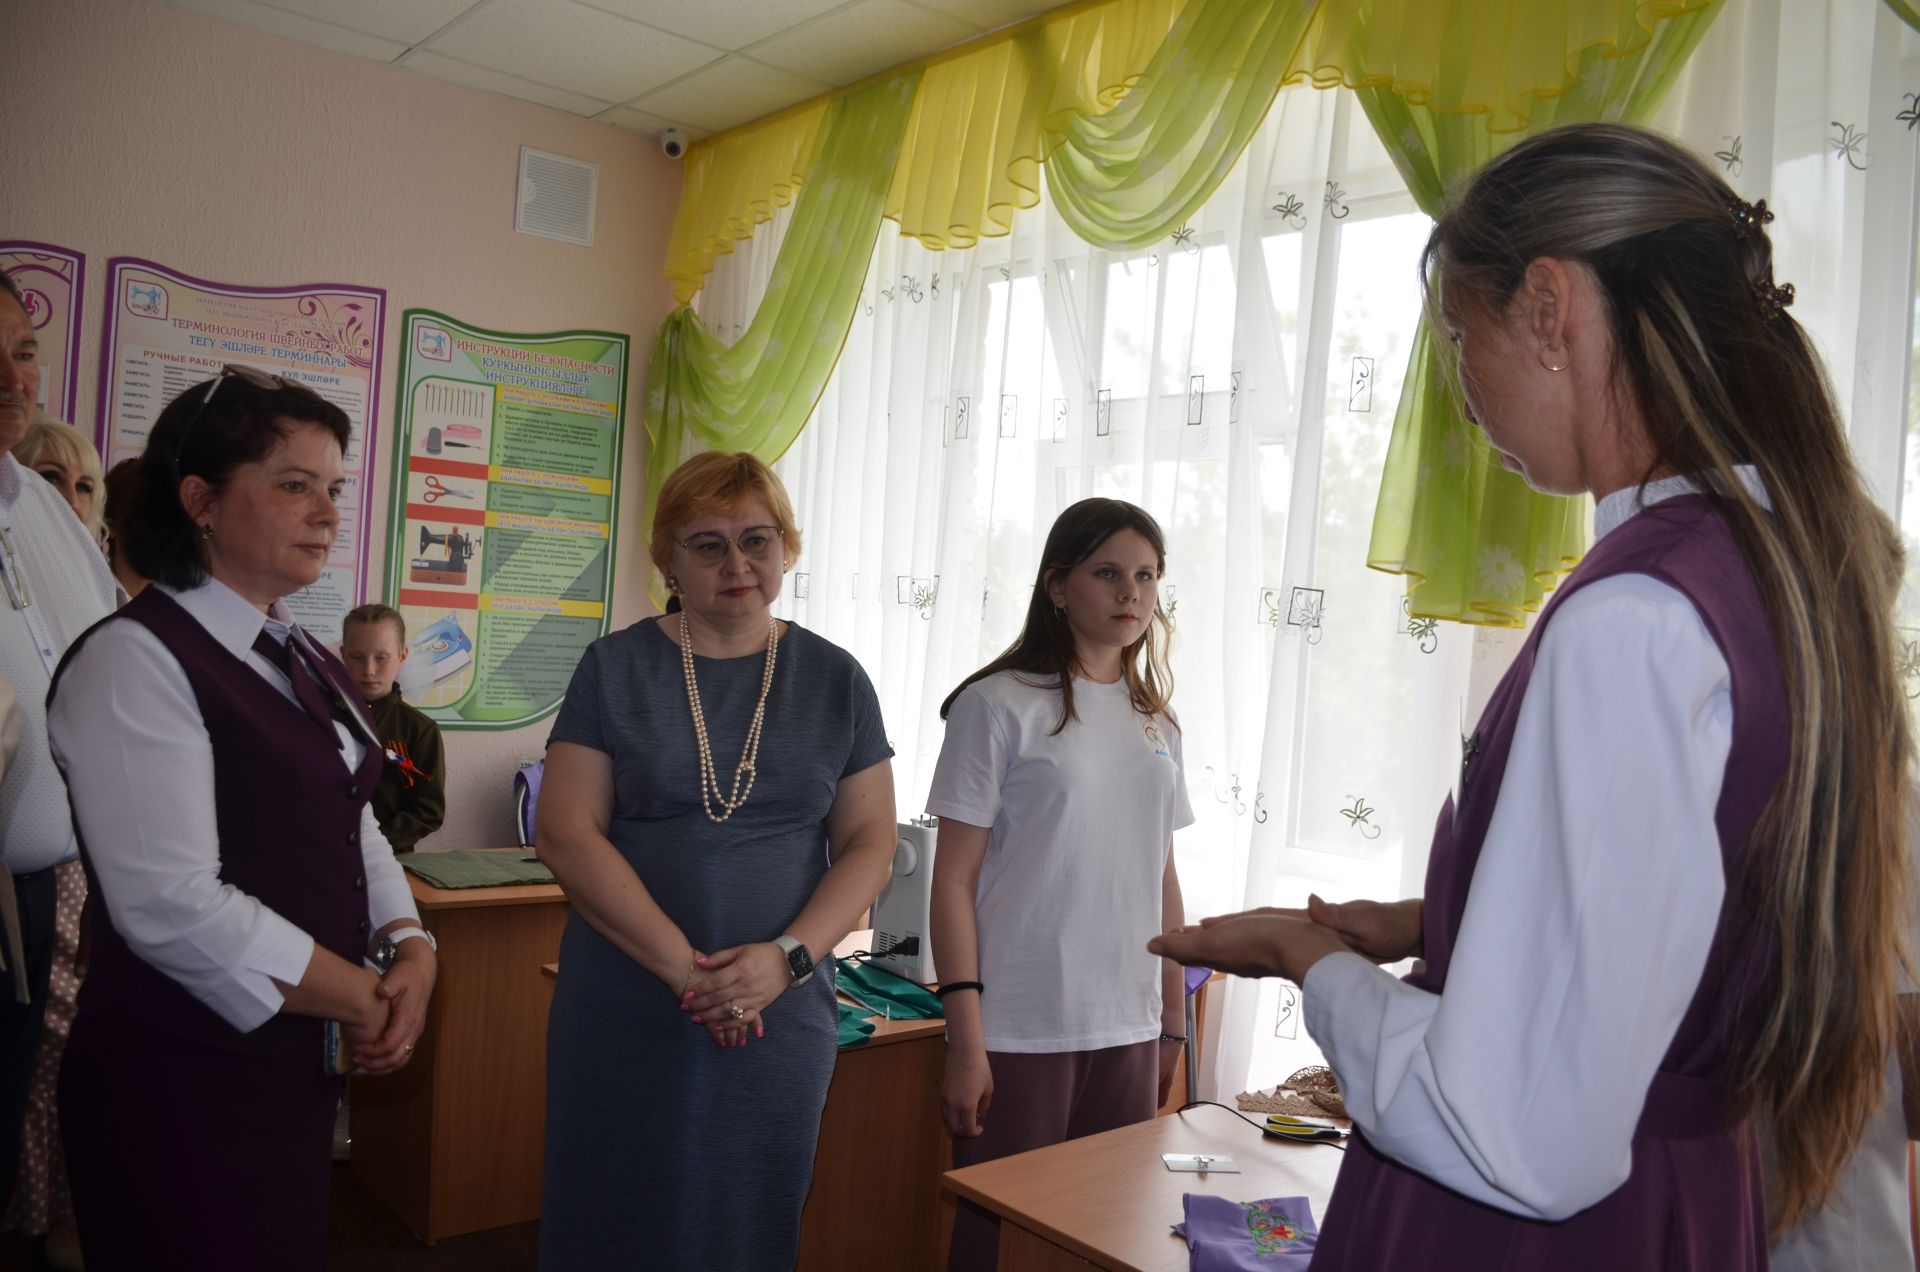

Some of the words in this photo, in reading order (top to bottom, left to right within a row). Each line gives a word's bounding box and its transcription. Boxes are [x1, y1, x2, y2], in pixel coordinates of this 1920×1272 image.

[172, 318, 266, 341] ТЕРМИНОЛОГИЯ
[270, 334, 326, 351] ШВЕЙНЫХ
[330, 342, 365, 357] РАБОТ
[143, 350, 186, 363] РУЧНЫЕ
[189, 356, 231, 368] РАБОТ
[220, 340, 267, 355] ЭШЛӘРЕ
[271, 348, 347, 368] ТЕРМИННАРЫ
[456, 339, 530, 361] ИНСТРУКЦИИ
[534, 353, 616, 376] БЕЗОПАСНОСТИ
[482, 357, 590, 384] КУРКЫНЫЧСЫЗЛЫК
[486, 371, 585, 396] ИНСТРУКЦИЯЛӘРЕ
